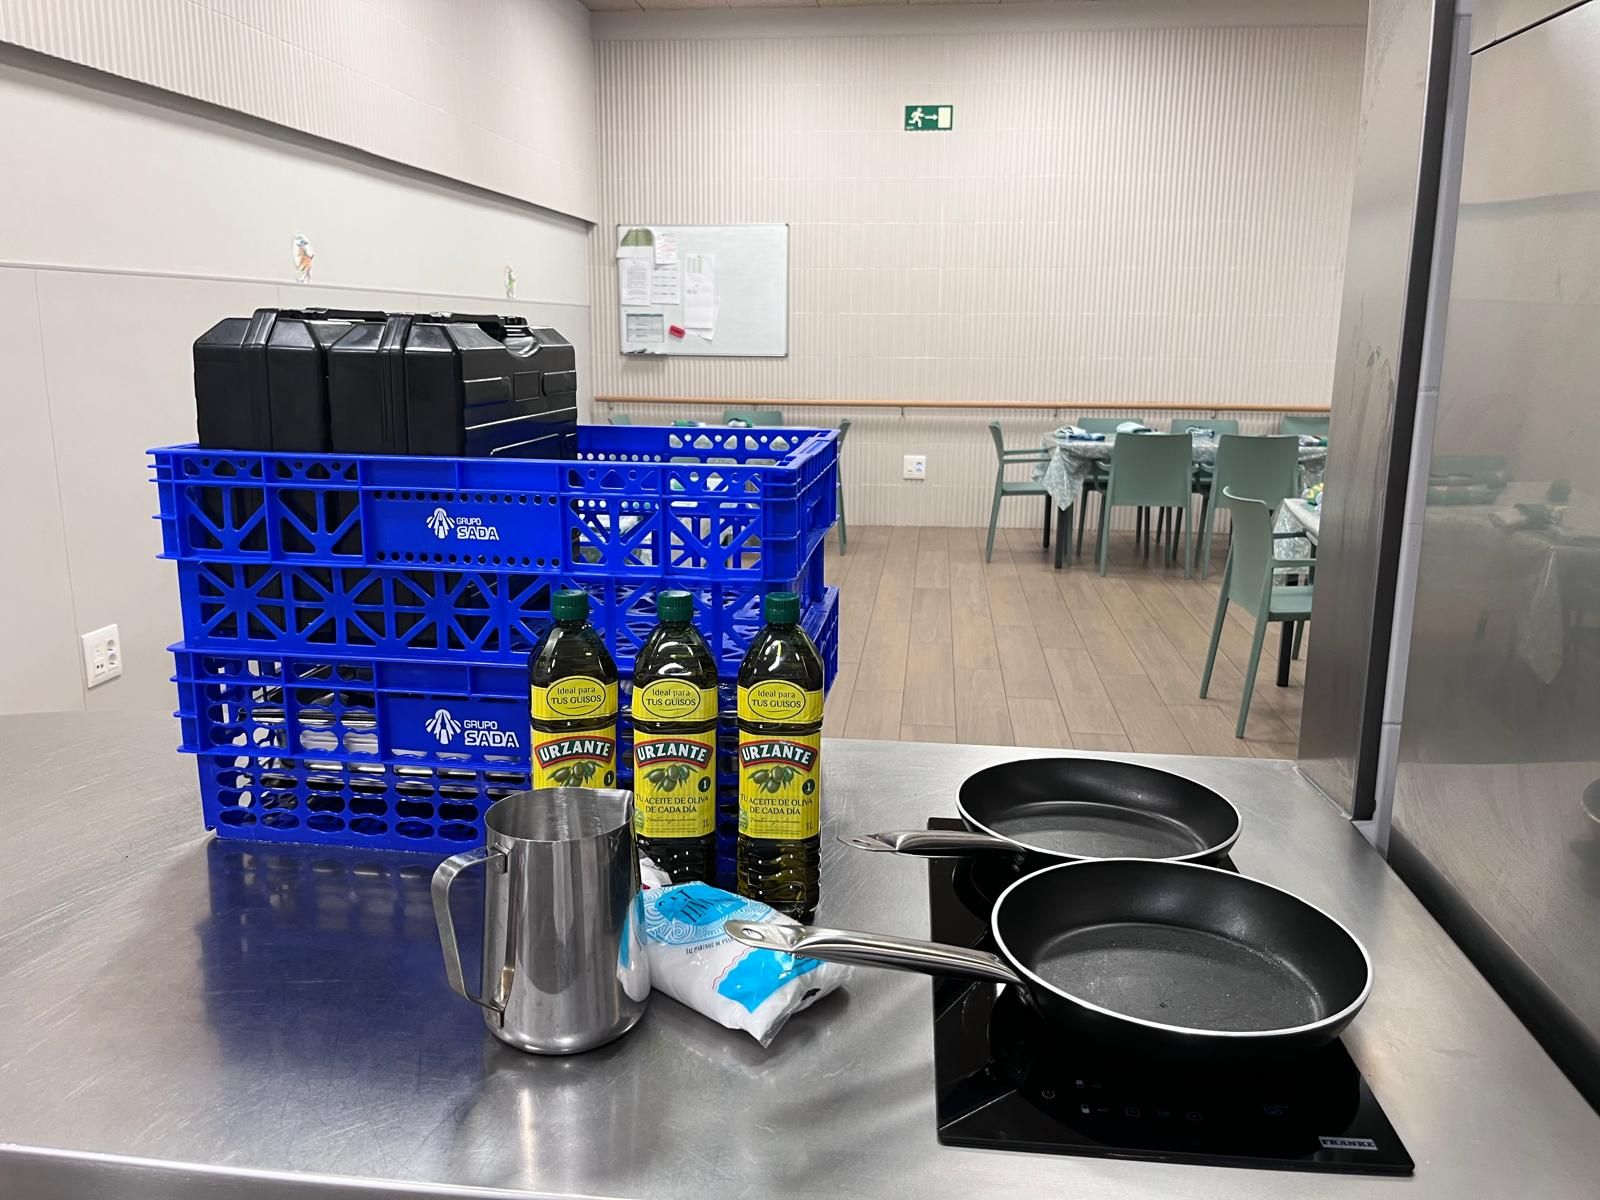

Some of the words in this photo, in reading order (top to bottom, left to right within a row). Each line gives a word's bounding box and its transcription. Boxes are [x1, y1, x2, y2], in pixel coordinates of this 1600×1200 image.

[456, 517, 482, 526] GRUPO
[457, 526, 499, 541] SADA
[557, 687, 576, 695] Ideal
[578, 687, 596, 695] para
[551, 697, 568, 705] TUS
[569, 695, 602, 705] GUISOS
[646, 698, 663, 706] TUS
[664, 698, 697, 706] GUISOS
[752, 699, 768, 707] TUS
[769, 700, 802, 708] GUISOS
[463, 720, 498, 730] GRUPO
[464, 730, 520, 748] SADA
[539, 740, 611, 762] URZANTE
[637, 743, 707, 762] URZANTE
[742, 744, 812, 765] URZANTE
[687, 795, 709, 804] OLIVA
[749, 798, 776, 806] ACEITE
[778, 798, 790, 806] DE
[791, 798, 813, 807] OLIVA
[682, 804, 697, 813] DÍA
[749, 806, 760, 814] DE
[761, 807, 785, 815] CADA
[786, 806, 801, 815] DÍA
